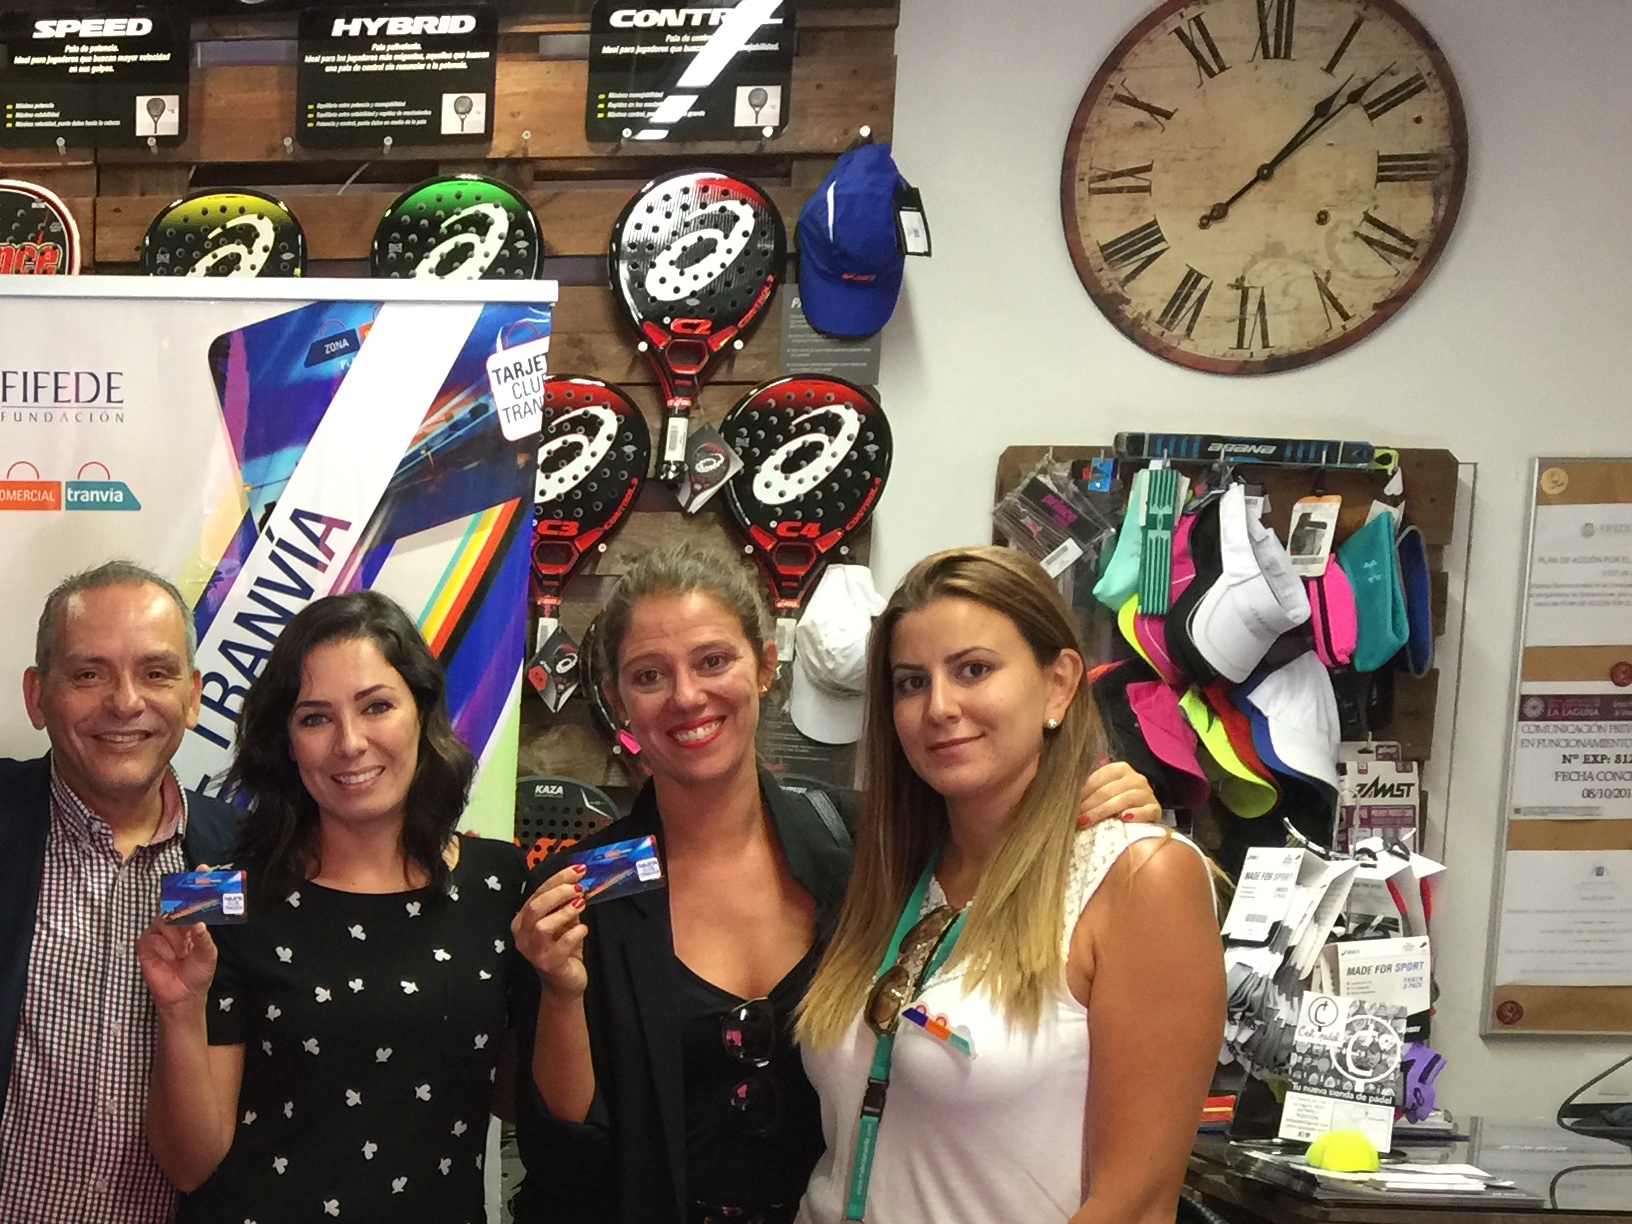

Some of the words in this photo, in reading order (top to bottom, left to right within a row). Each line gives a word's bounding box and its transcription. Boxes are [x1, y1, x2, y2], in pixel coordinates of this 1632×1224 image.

[331, 15, 476, 37] HYBRID
[609, 8, 784, 28] CONTR
[32, 17, 153, 39] SPEED
[670, 317, 714, 335] C2
[325, 338, 350, 355] ZONA
[1, 370, 125, 404] FIFEDE
[1, 409, 125, 423] FUNDACIÓN
[536, 520, 580, 537] C3
[776, 520, 821, 538] C4
[1582, 753, 1611, 764] EXP:
[1554, 770, 1594, 782] FECHA
[534, 784, 564, 796] KAZA
[1346, 964, 1373, 976] MADE
[1374, 963, 1393, 975] FOR
[1394, 961, 1425, 973] SPORT
[1292, 1081, 1302, 1091] Tu
[1302, 1084, 1328, 1096] nueva
[1328, 1088, 1355, 1100] tienda
[1355, 1092, 1368, 1102] de
